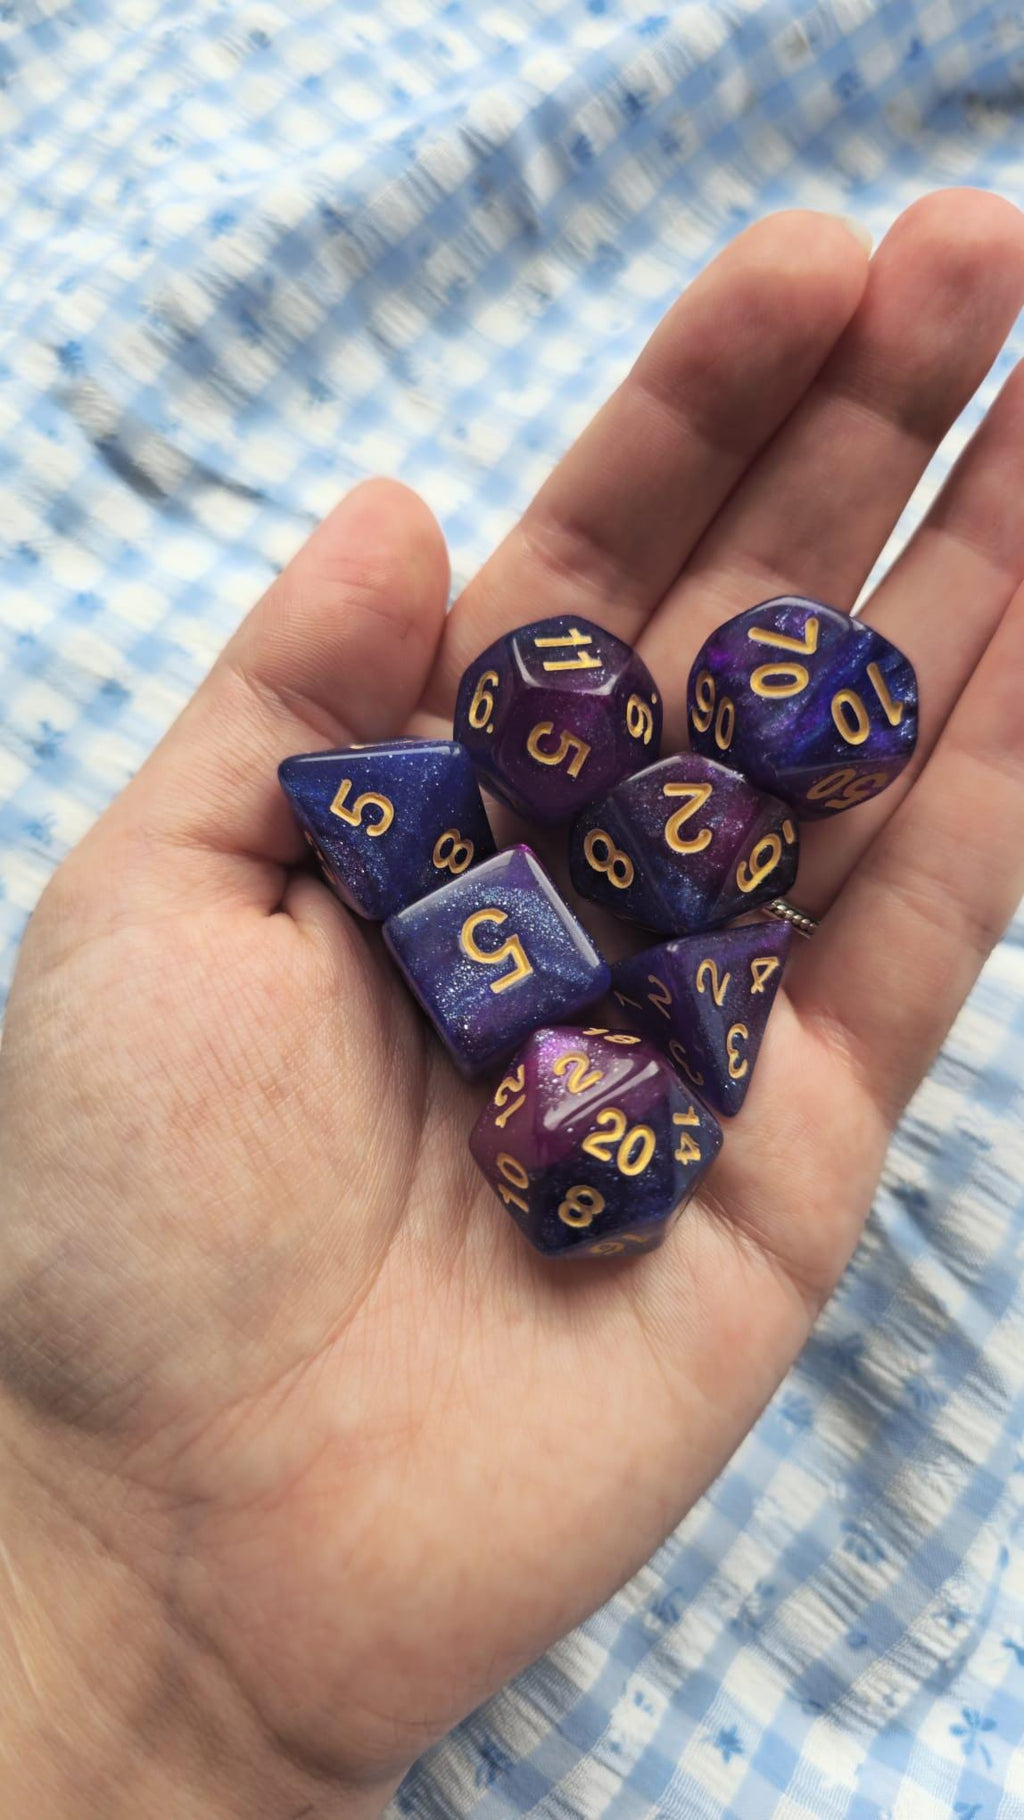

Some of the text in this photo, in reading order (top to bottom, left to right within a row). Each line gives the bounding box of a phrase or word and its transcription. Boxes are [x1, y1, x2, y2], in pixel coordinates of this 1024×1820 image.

[534, 627, 602, 671] 11
[747, 617, 819, 698] 70
[831, 662, 903, 745] 10
[527, 722, 591, 778] 5
[329, 778, 395, 837] 5
[663, 783, 713, 853] 2
[432, 828, 474, 875] 8
[584, 828, 634, 889] 8
[460, 908, 534, 994] 5
[750, 956, 780, 994] 4
[697, 958, 731, 1006] 2
[553, 1052, 604, 1094] 2
[727, 1023, 749, 1079] 3
[494, 1064, 527, 1128] 12
[582, 1107, 656, 1177] 20
[672, 1105, 702, 1166] 14
[497, 1152, 530, 1213] 10
[558, 1184, 606, 1228] 8
